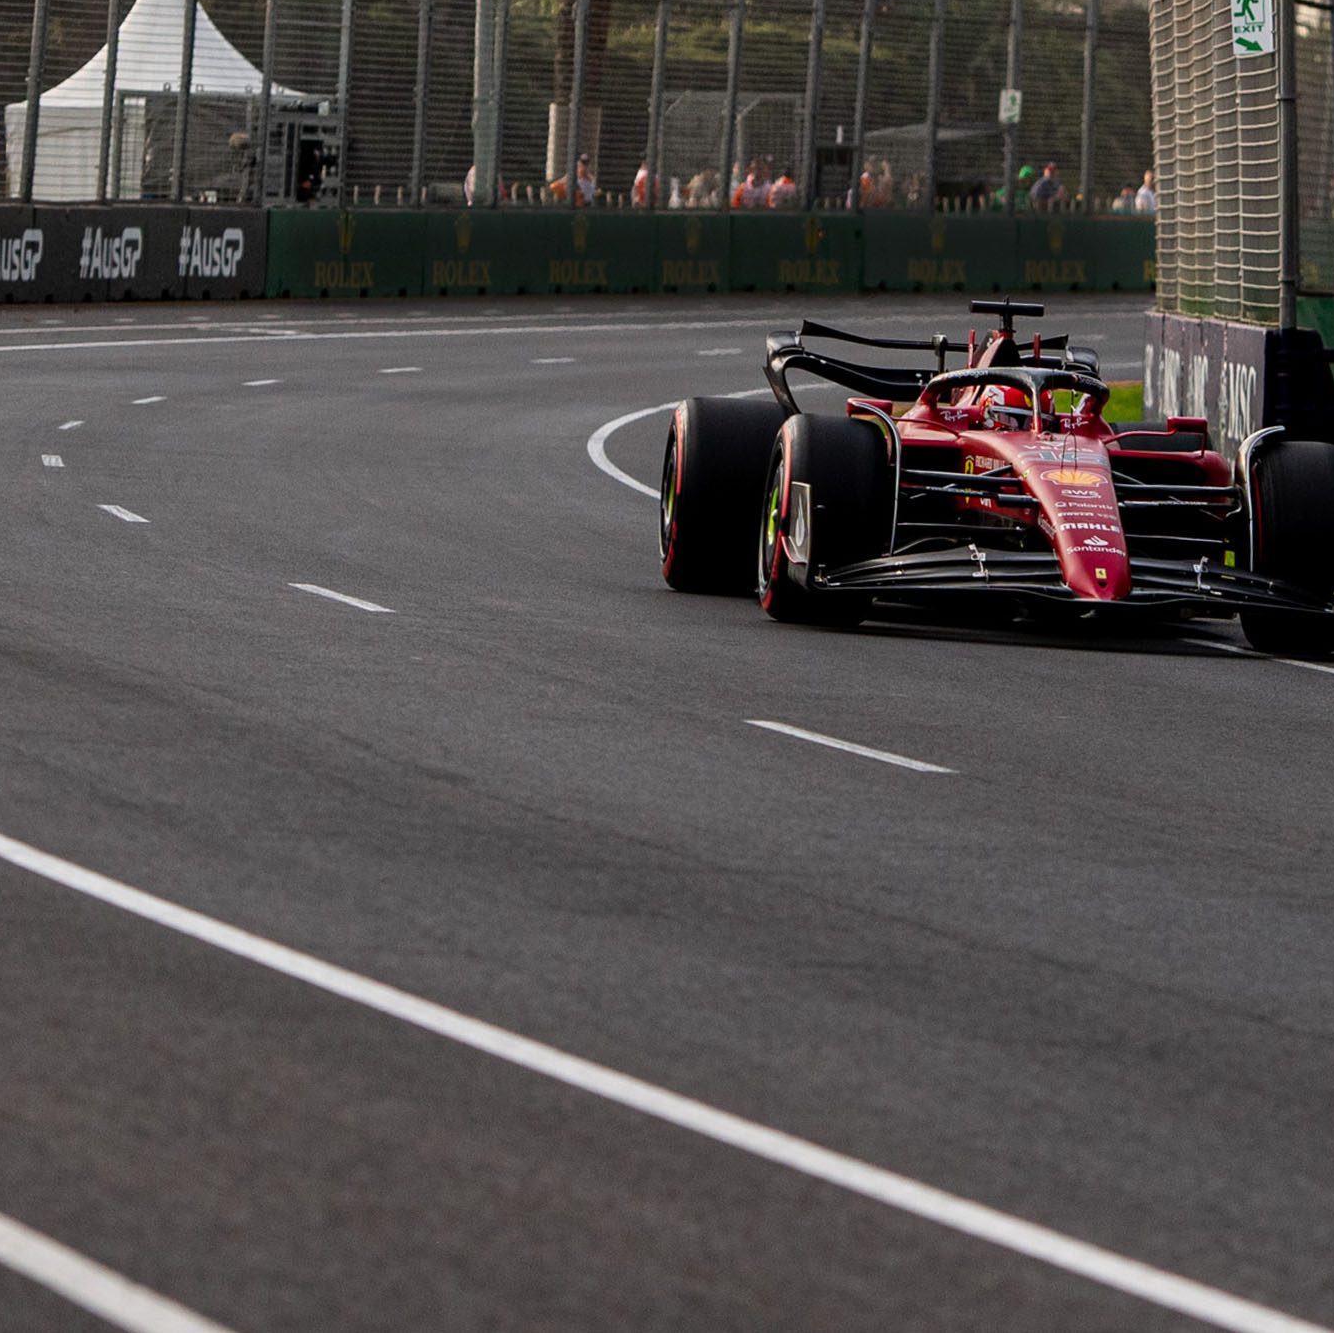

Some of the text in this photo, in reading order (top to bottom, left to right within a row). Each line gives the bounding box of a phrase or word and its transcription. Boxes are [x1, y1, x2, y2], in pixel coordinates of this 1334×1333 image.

[1234, 25, 1264, 34] EXIT
[315, 260, 374, 288] ROLEX
[432, 259, 492, 286] ROLEX
[548, 259, 608, 285] ROLEX
[1060, 522, 1121, 534] MAHLE
